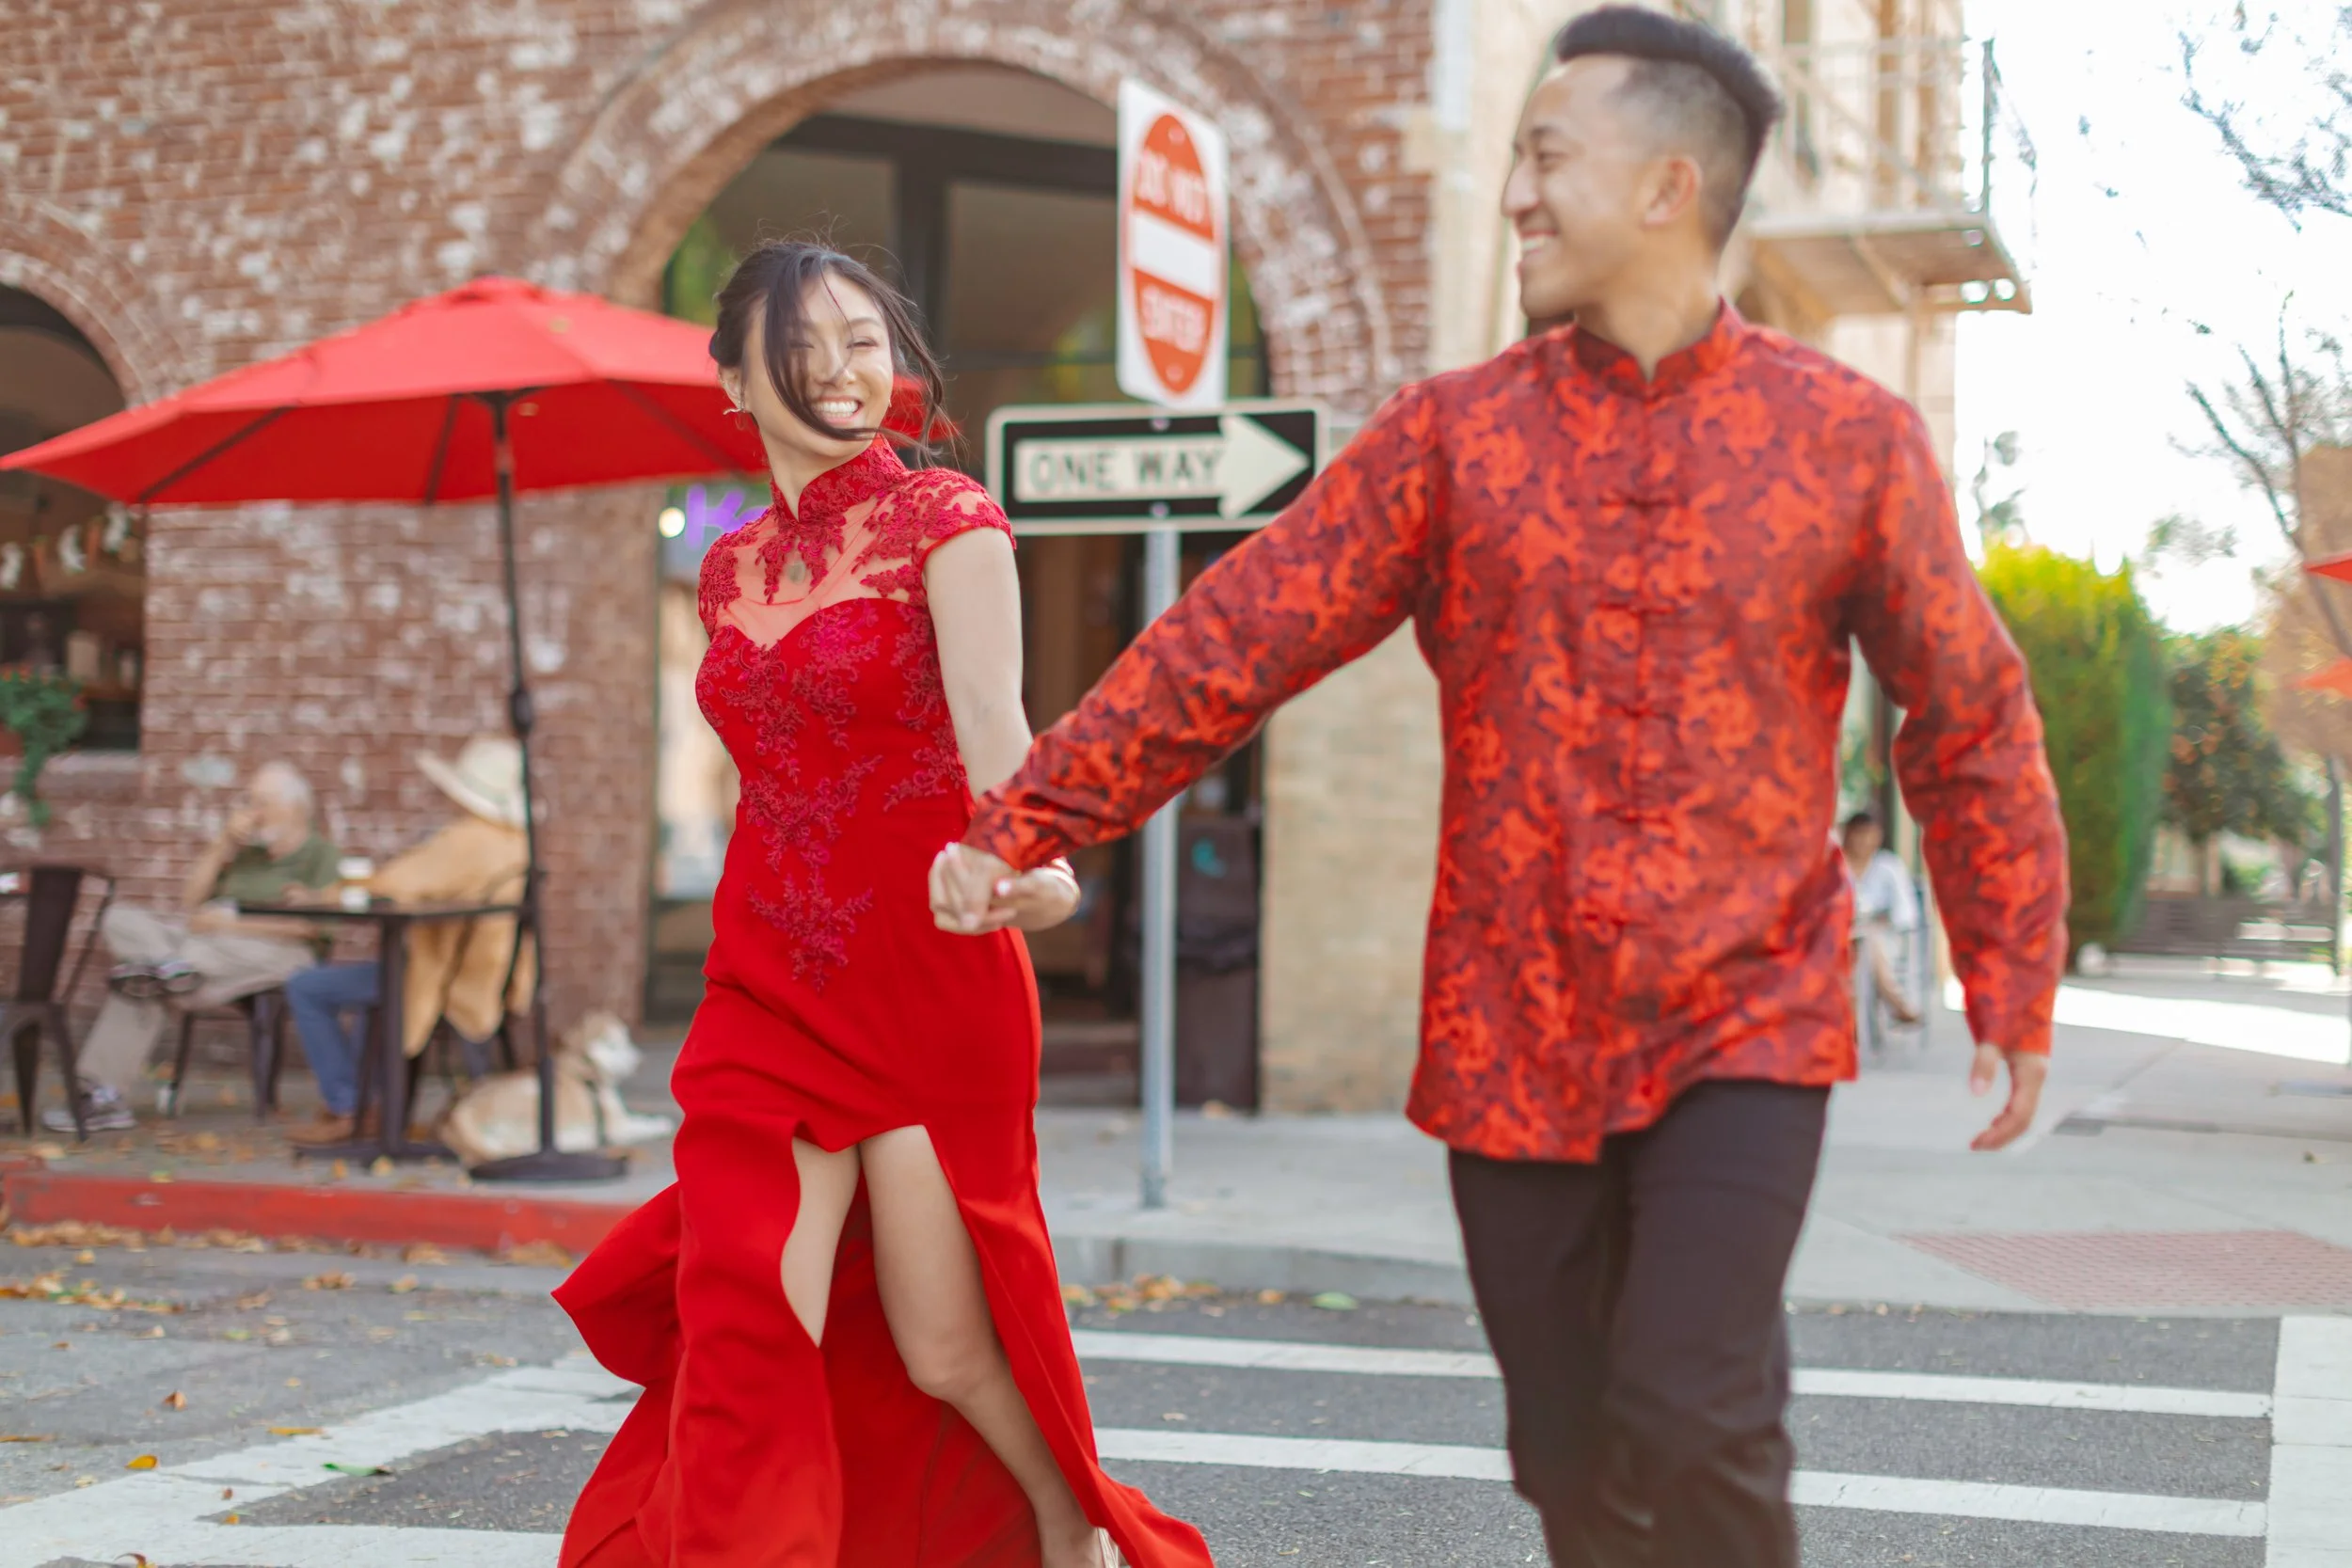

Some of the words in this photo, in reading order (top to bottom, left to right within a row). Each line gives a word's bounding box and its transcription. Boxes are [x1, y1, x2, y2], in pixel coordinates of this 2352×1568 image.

[1136, 149, 1168, 207] DO
[1170, 166, 1207, 225] NOT
[1141, 285, 1207, 354] ENTER
[1030, 450, 1117, 493] ONE
[1134, 446, 1223, 489] WAY
